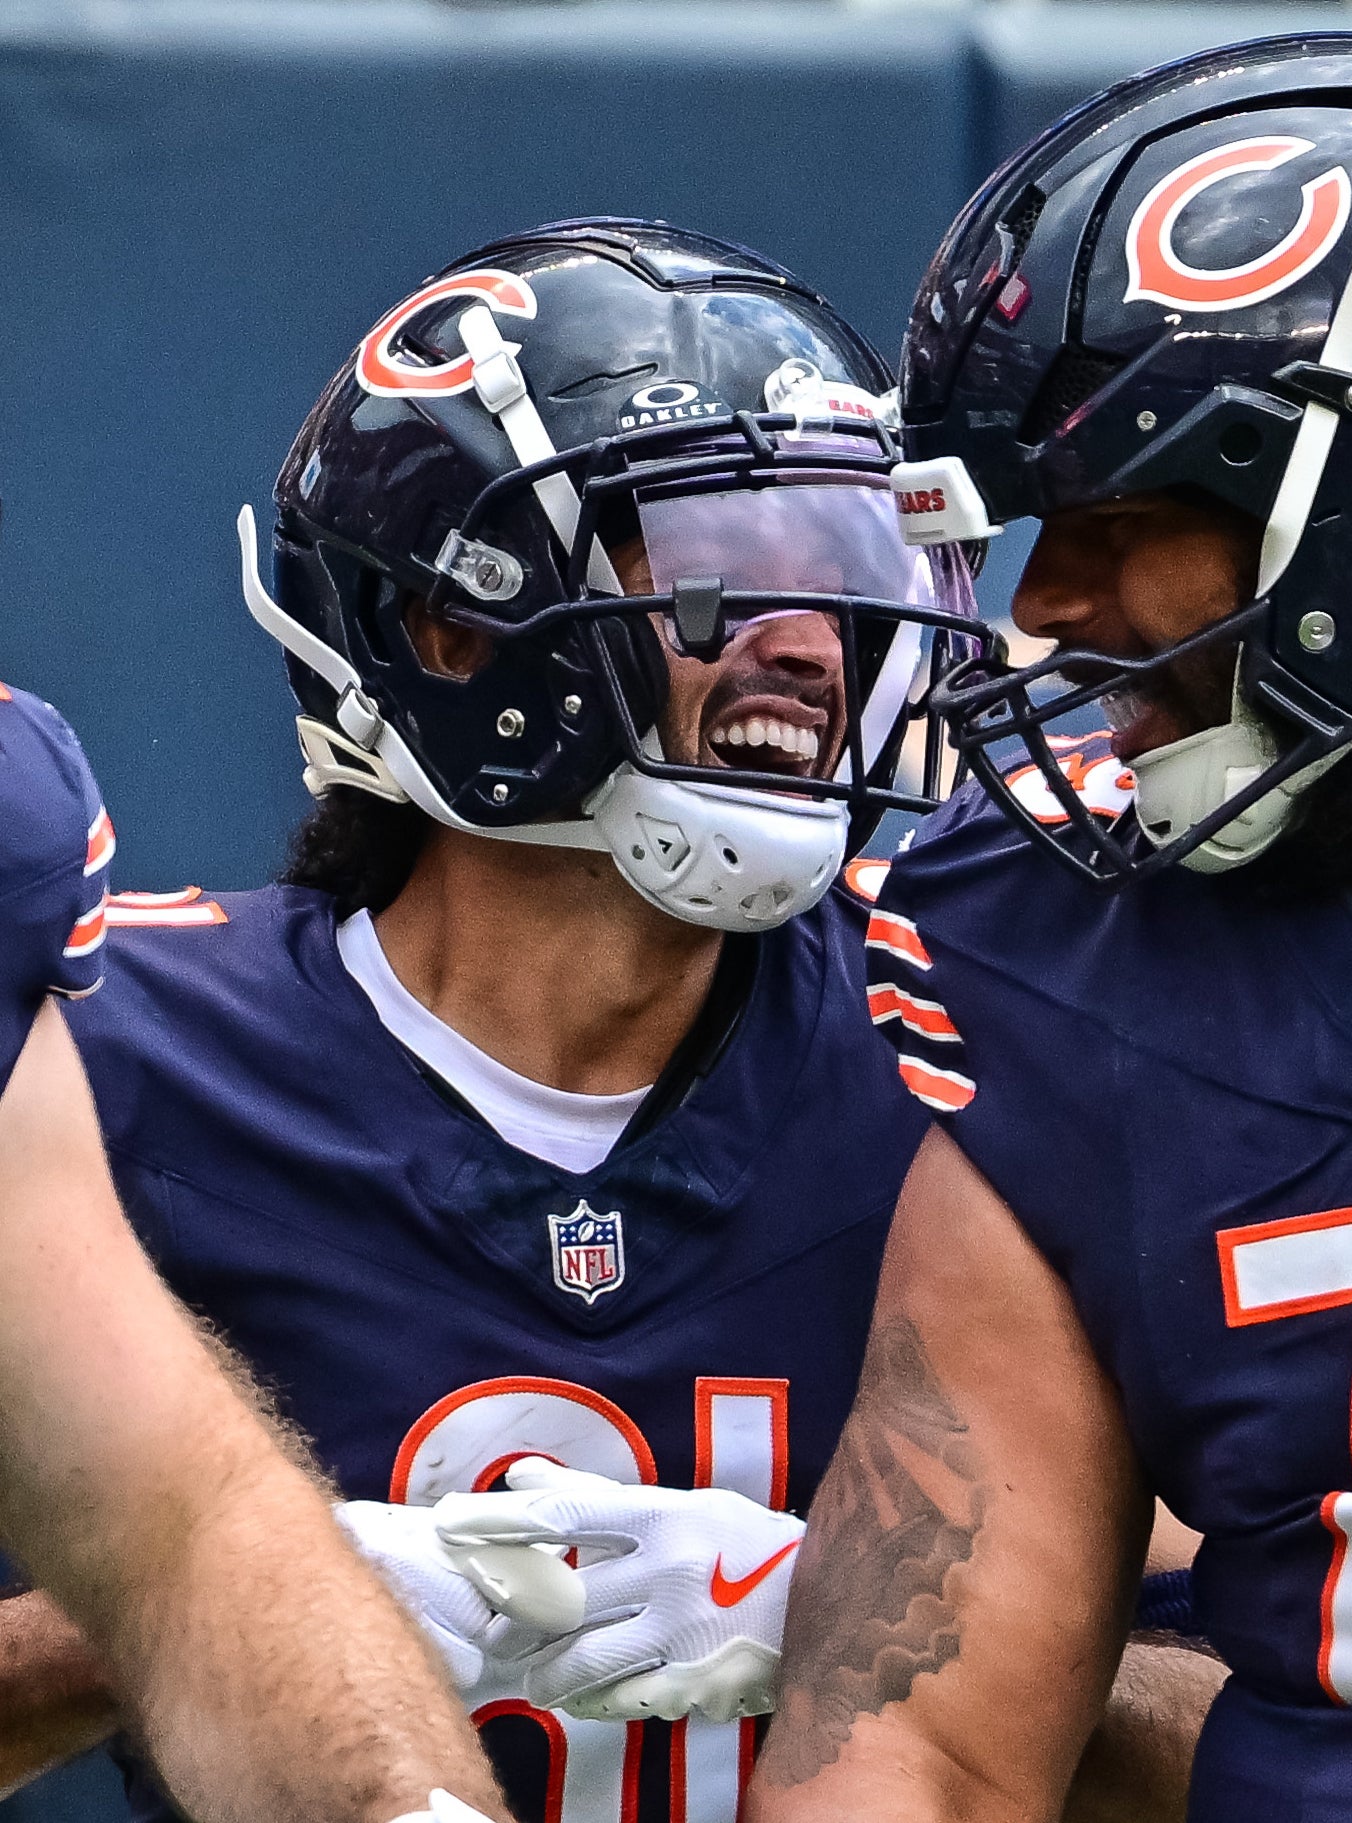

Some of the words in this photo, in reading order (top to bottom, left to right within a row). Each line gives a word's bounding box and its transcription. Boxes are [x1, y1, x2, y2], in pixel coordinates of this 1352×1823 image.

[1123, 135, 1352, 312] C
[621, 402, 722, 428] OAKLEY
[828, 399, 876, 420] EARS
[894, 487, 946, 514] EARS
[564, 1248, 614, 1285] NFL
